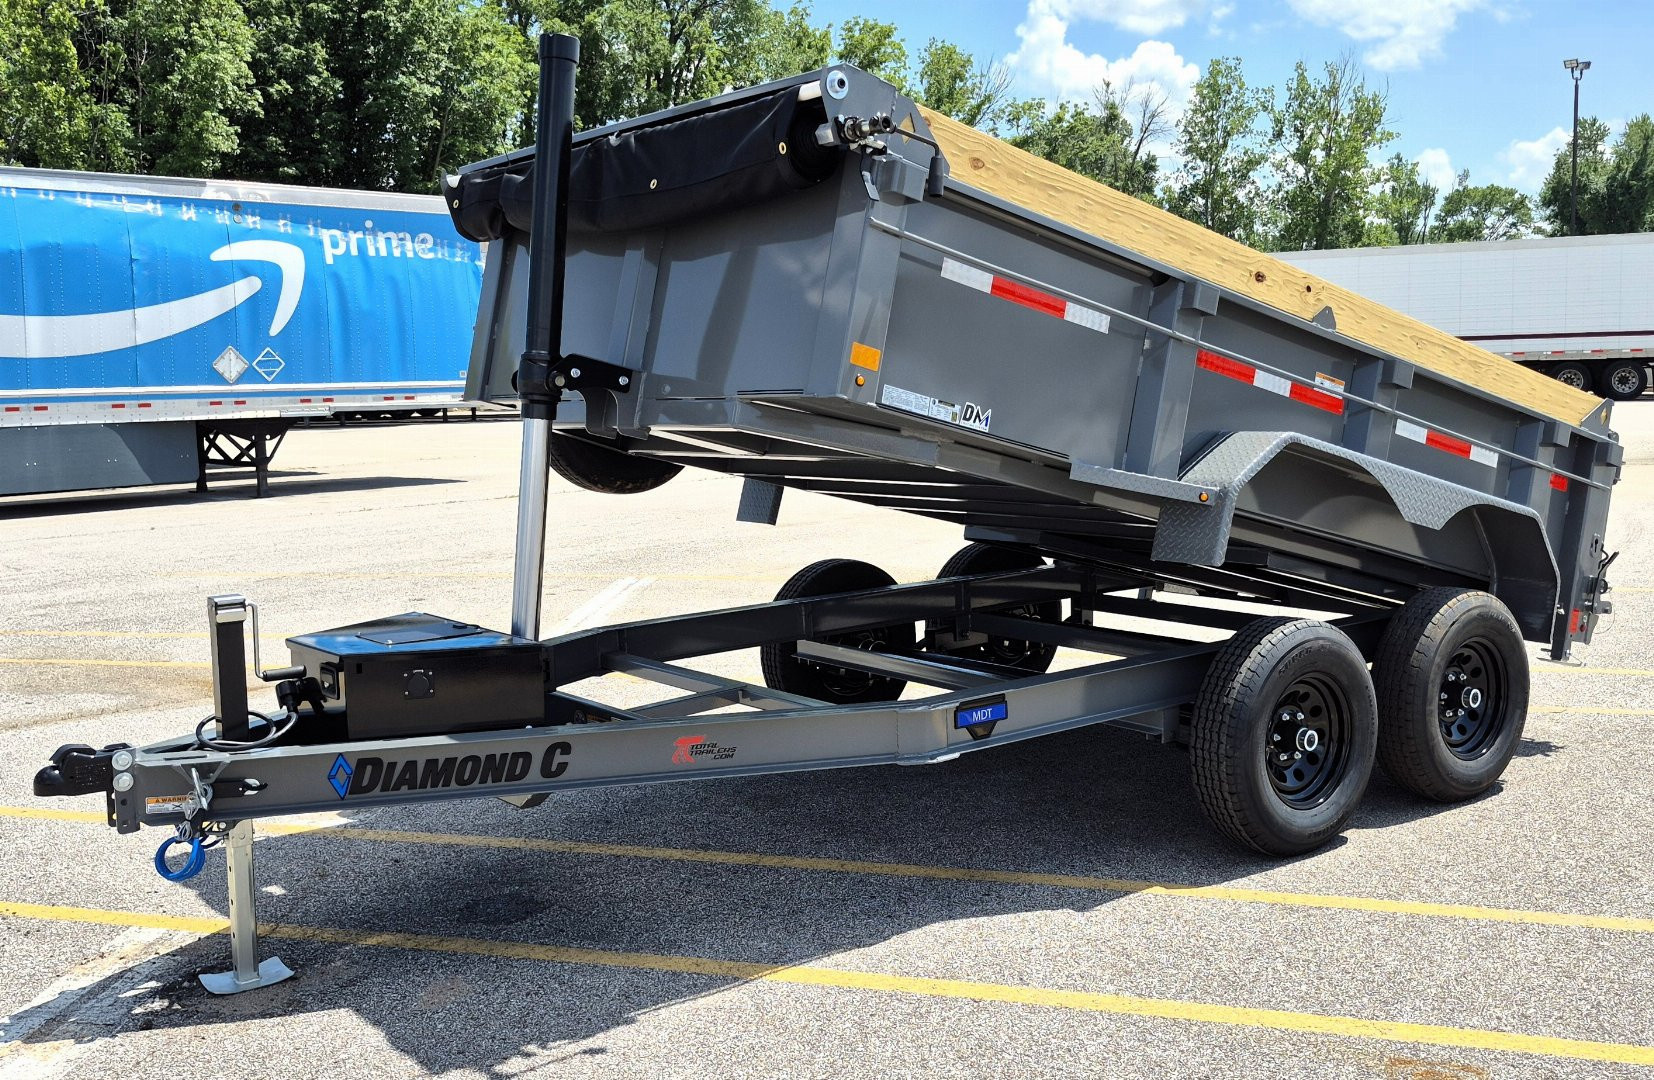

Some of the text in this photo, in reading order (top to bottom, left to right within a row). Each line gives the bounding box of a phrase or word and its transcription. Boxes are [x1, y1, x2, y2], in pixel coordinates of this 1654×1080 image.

[321, 220, 435, 265] prime
[962, 404, 989, 427] DM
[972, 708, 992, 722] MDT
[690, 742, 718, 750] TOTAL
[690, 747, 737, 756] TRAILERS
[349, 741, 572, 796] DIAMOND C
